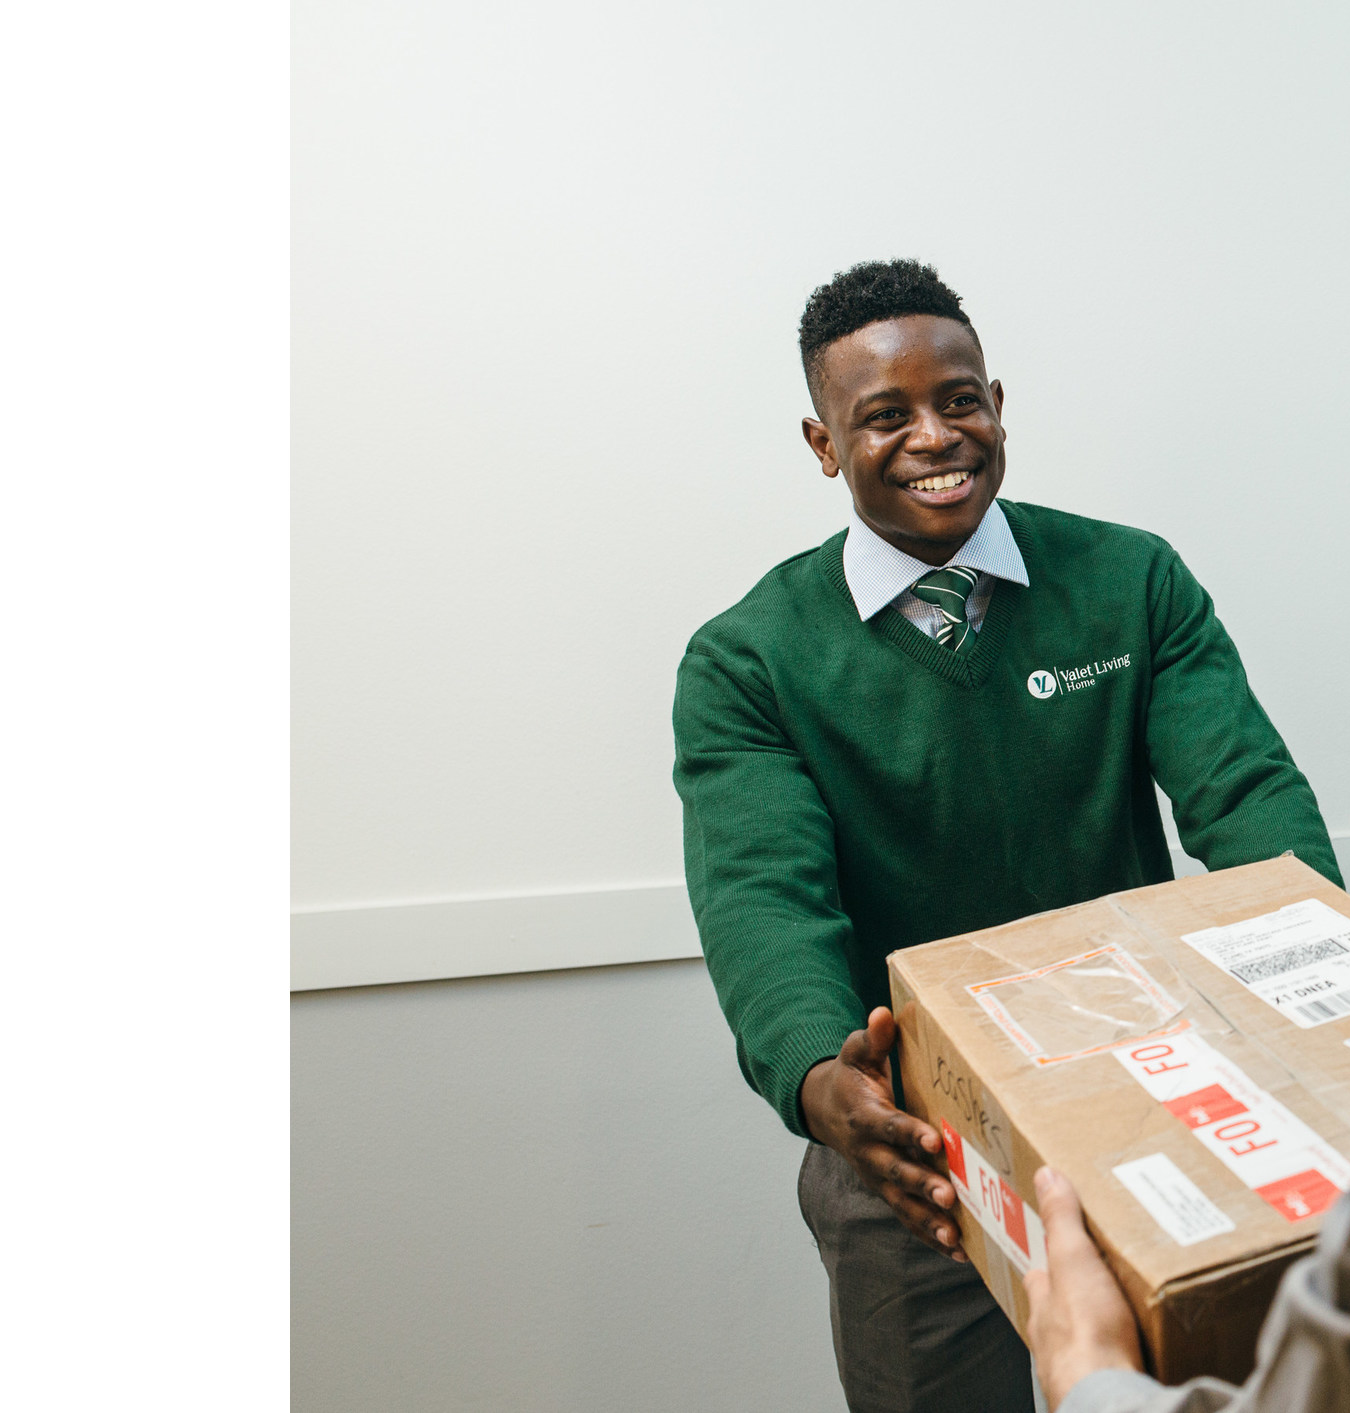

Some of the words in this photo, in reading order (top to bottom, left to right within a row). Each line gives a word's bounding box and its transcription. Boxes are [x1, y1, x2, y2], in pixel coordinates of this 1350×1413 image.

[1060, 664, 1094, 682] Valet
[1094, 653, 1131, 675] Living
[1066, 678, 1096, 692] Home
[1130, 1044, 1189, 1076] FO
[1214, 1119, 1279, 1157] FO
[978, 1166, 1001, 1223] FO
